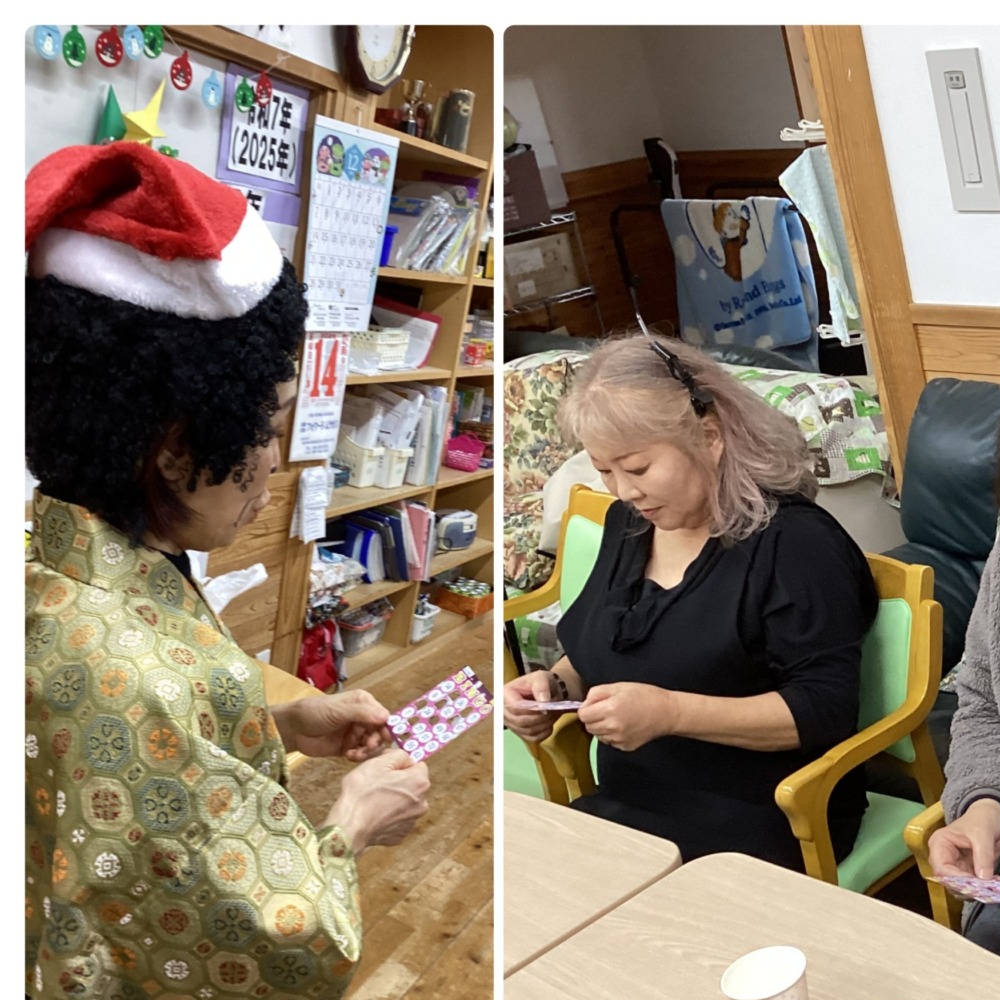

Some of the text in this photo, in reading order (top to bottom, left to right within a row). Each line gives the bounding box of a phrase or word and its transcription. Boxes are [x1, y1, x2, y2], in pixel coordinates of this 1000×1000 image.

[231, 125, 296, 178] (2025年)
[347, 153, 359, 171] 12
[309, 339, 339, 398] 14
